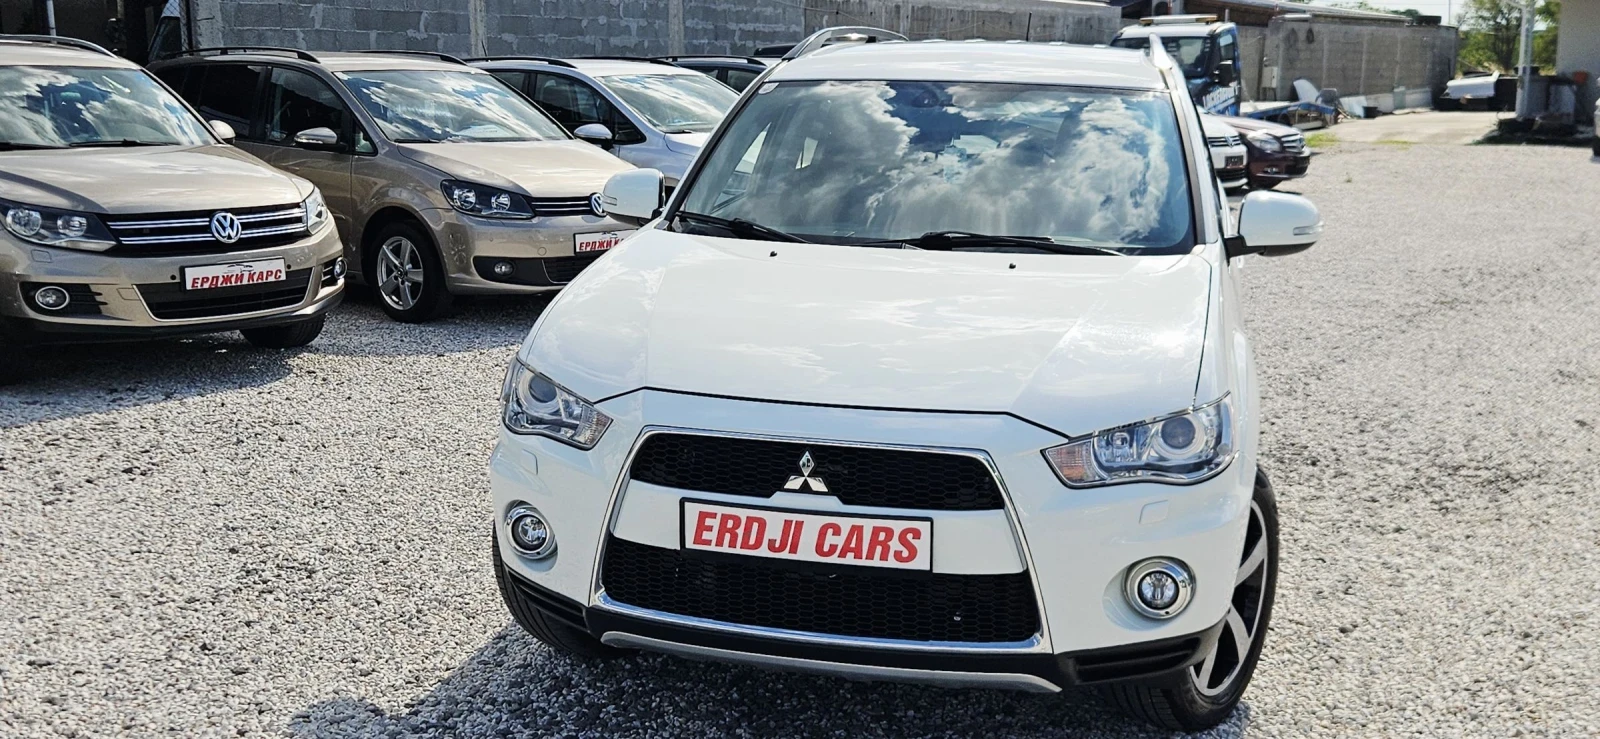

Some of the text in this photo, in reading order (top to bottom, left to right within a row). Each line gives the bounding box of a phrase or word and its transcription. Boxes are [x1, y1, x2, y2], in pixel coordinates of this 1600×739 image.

[579, 239, 613, 252] ЕРДЖИ
[191, 269, 282, 288] ЕРДЖИ КАРС
[692, 510, 922, 564] ERDJI CARS
